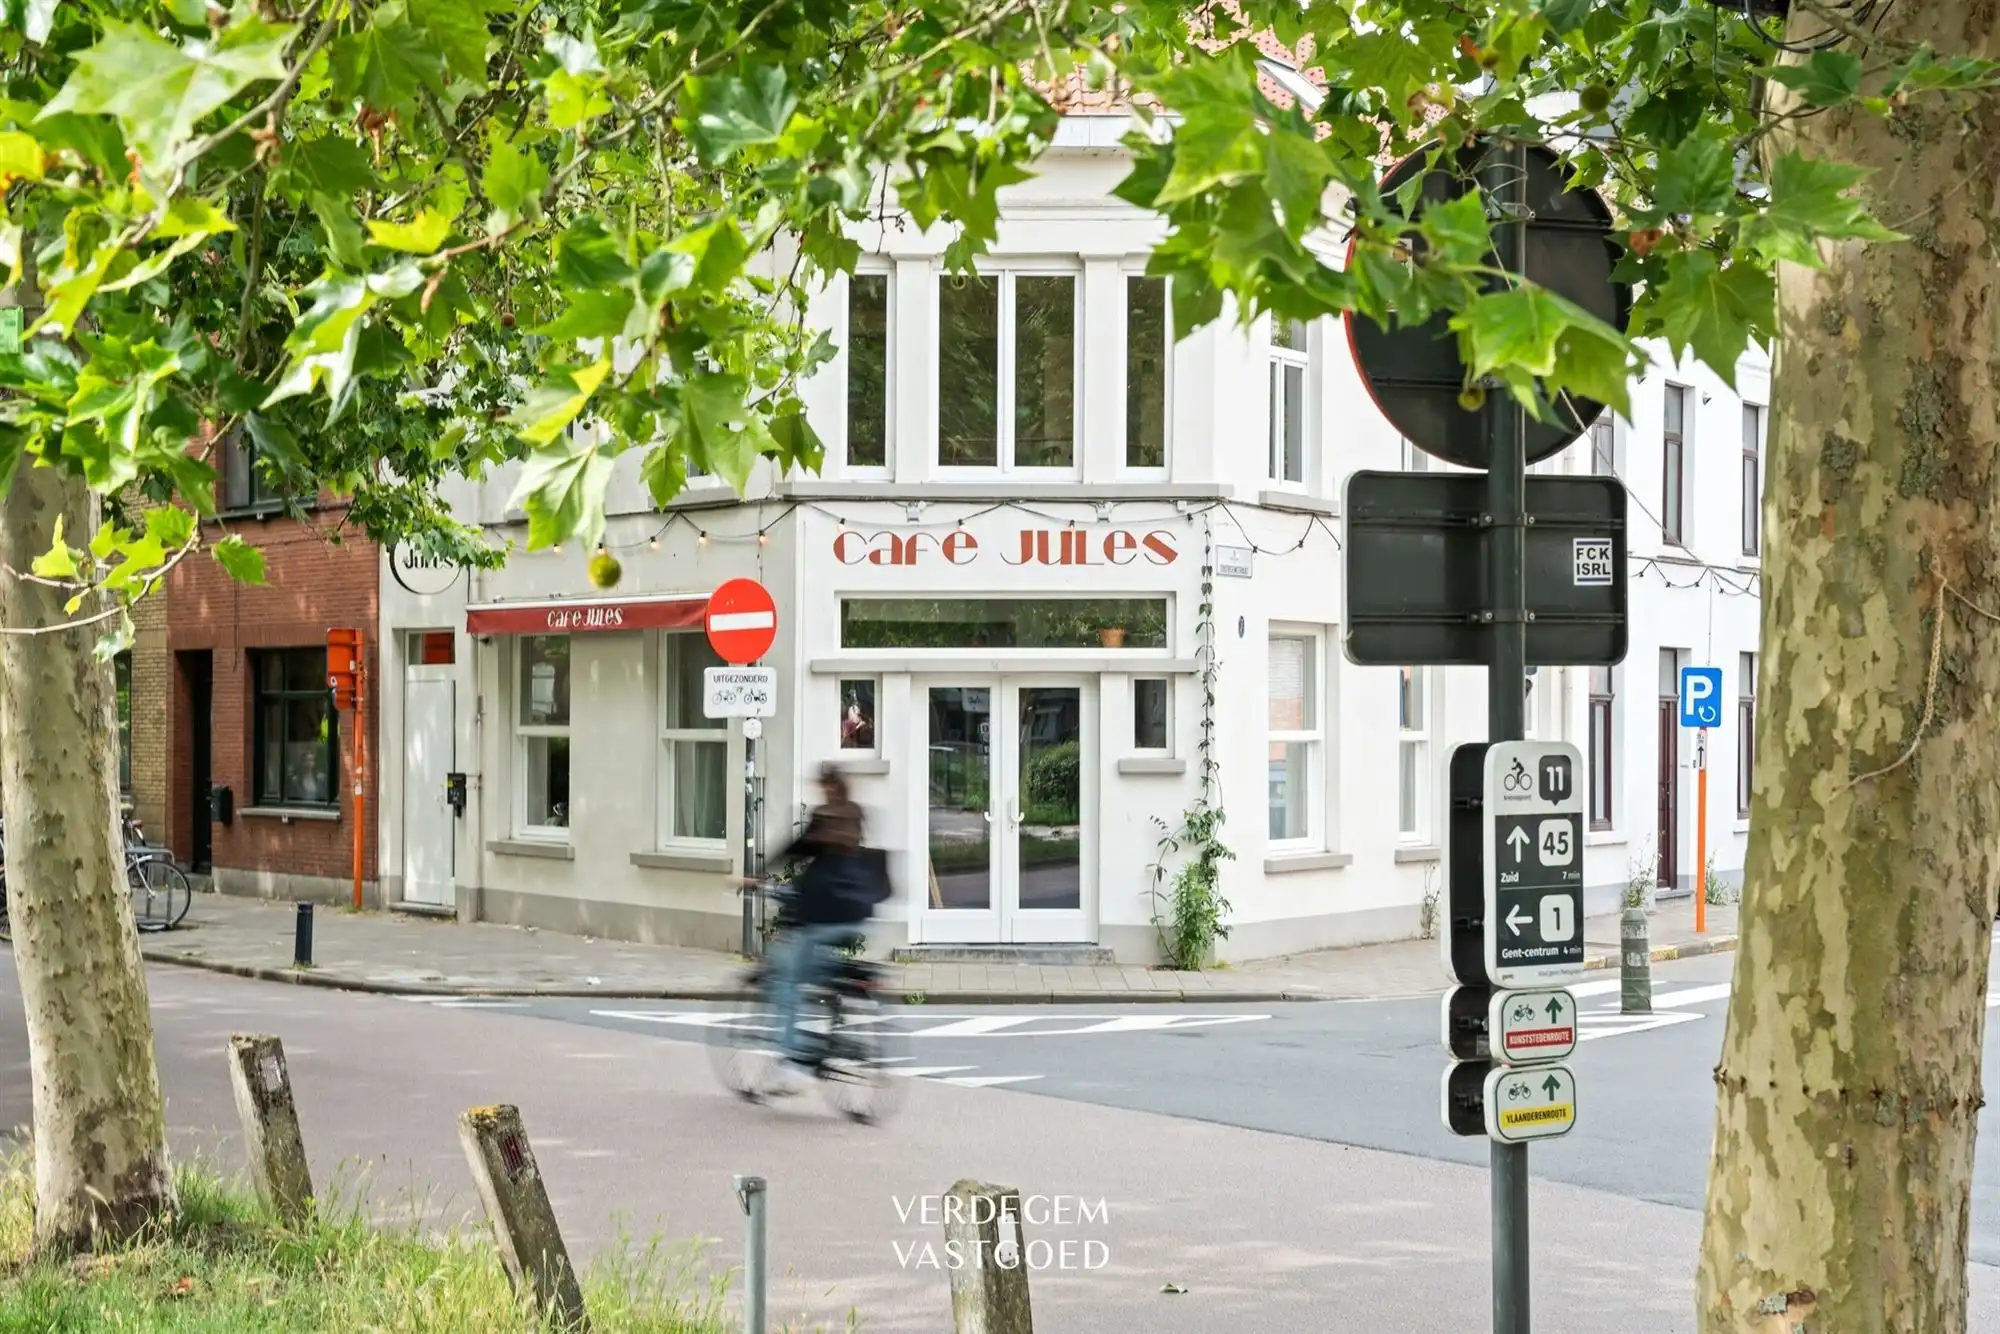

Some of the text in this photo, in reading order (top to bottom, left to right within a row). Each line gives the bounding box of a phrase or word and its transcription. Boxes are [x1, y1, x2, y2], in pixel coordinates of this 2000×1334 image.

[1576, 547, 1610, 561] FCK
[1576, 562, 1611, 576] ISRL
[713, 674, 768, 684] UITGEZONDERD
[1685, 675, 1713, 715] P
[1546, 766, 1563, 792] 11
[1543, 831, 1568, 856] 45
[1500, 870, 1580, 884] Zuid 7 min
[1553, 906, 1561, 932] 1
[1502, 945, 1582, 959] Gent-centrum 4 min
[1509, 1030, 1569, 1046] KUNSTSTEDENROUTE
[1505, 1107, 1567, 1124] VLAANDERENROUTE
